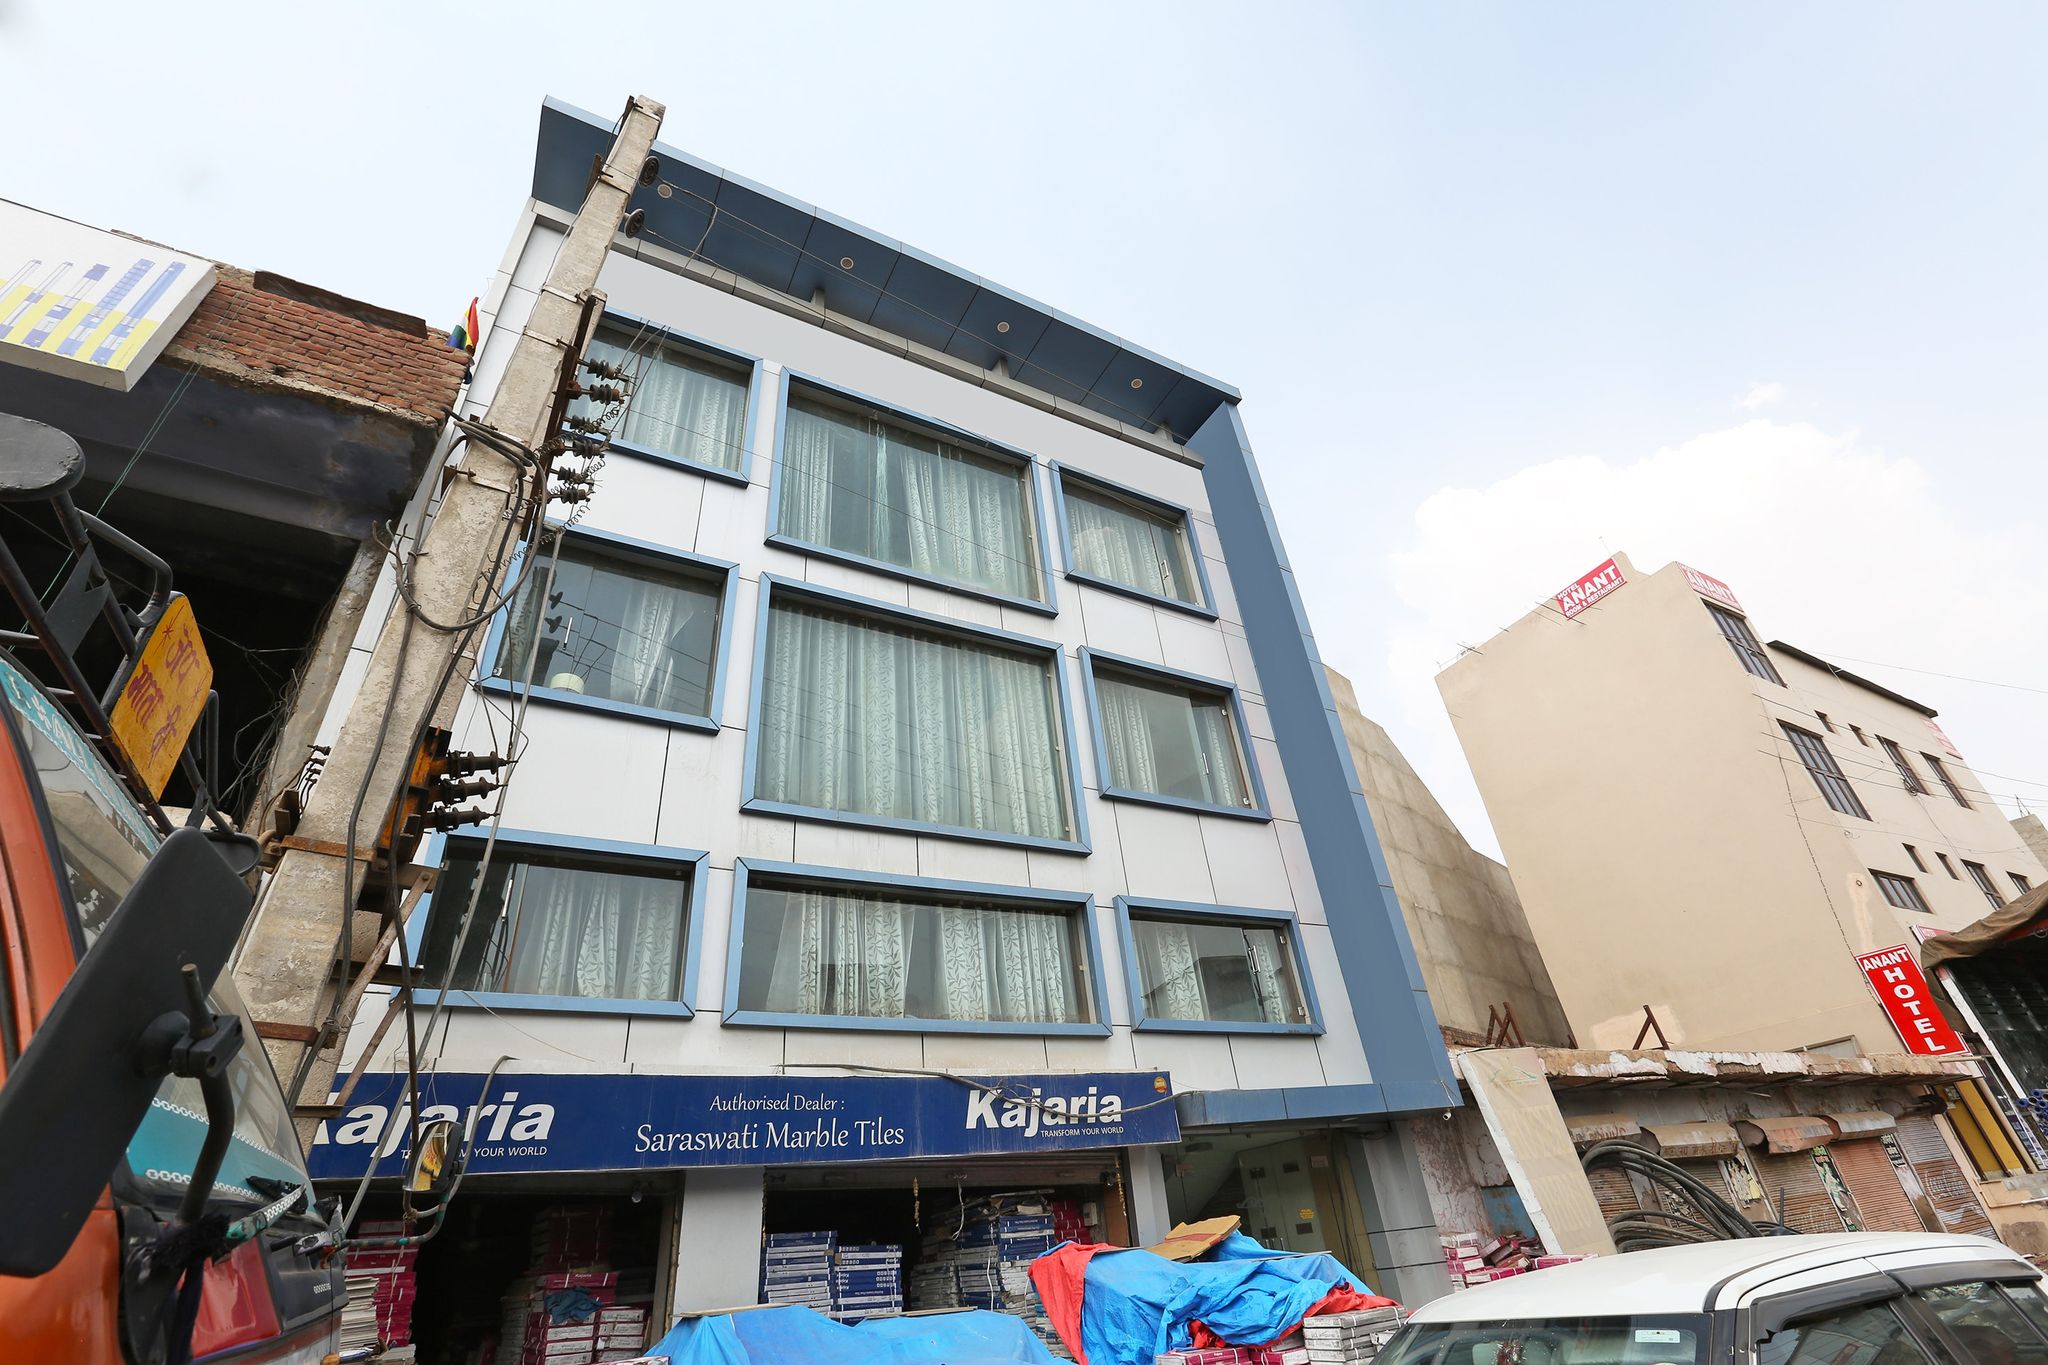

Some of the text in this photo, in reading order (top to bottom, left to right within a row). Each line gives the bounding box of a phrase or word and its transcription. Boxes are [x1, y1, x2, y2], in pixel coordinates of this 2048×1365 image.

[1557, 583, 1580, 600] HOTEL
[1563, 564, 1616, 611] ANANT
[1587, 576, 1623, 603] RESTAURANT
[1862, 949, 1908, 972] ANANT
[1882, 966, 1946, 1052] HOTEL
[709, 1092, 790, 1111] Authorised
[794, 1094, 837, 1110] Dealer
[966, 1086, 1122, 1138] Kajaria
[635, 1116, 904, 1152] Saraswati Marble Tiles
[1041, 1126, 1124, 1138] TRANSFORM YOUR WORLD
[474, 1147, 504, 1157] YOUR
[508, 1146, 548, 1156] WORLD
